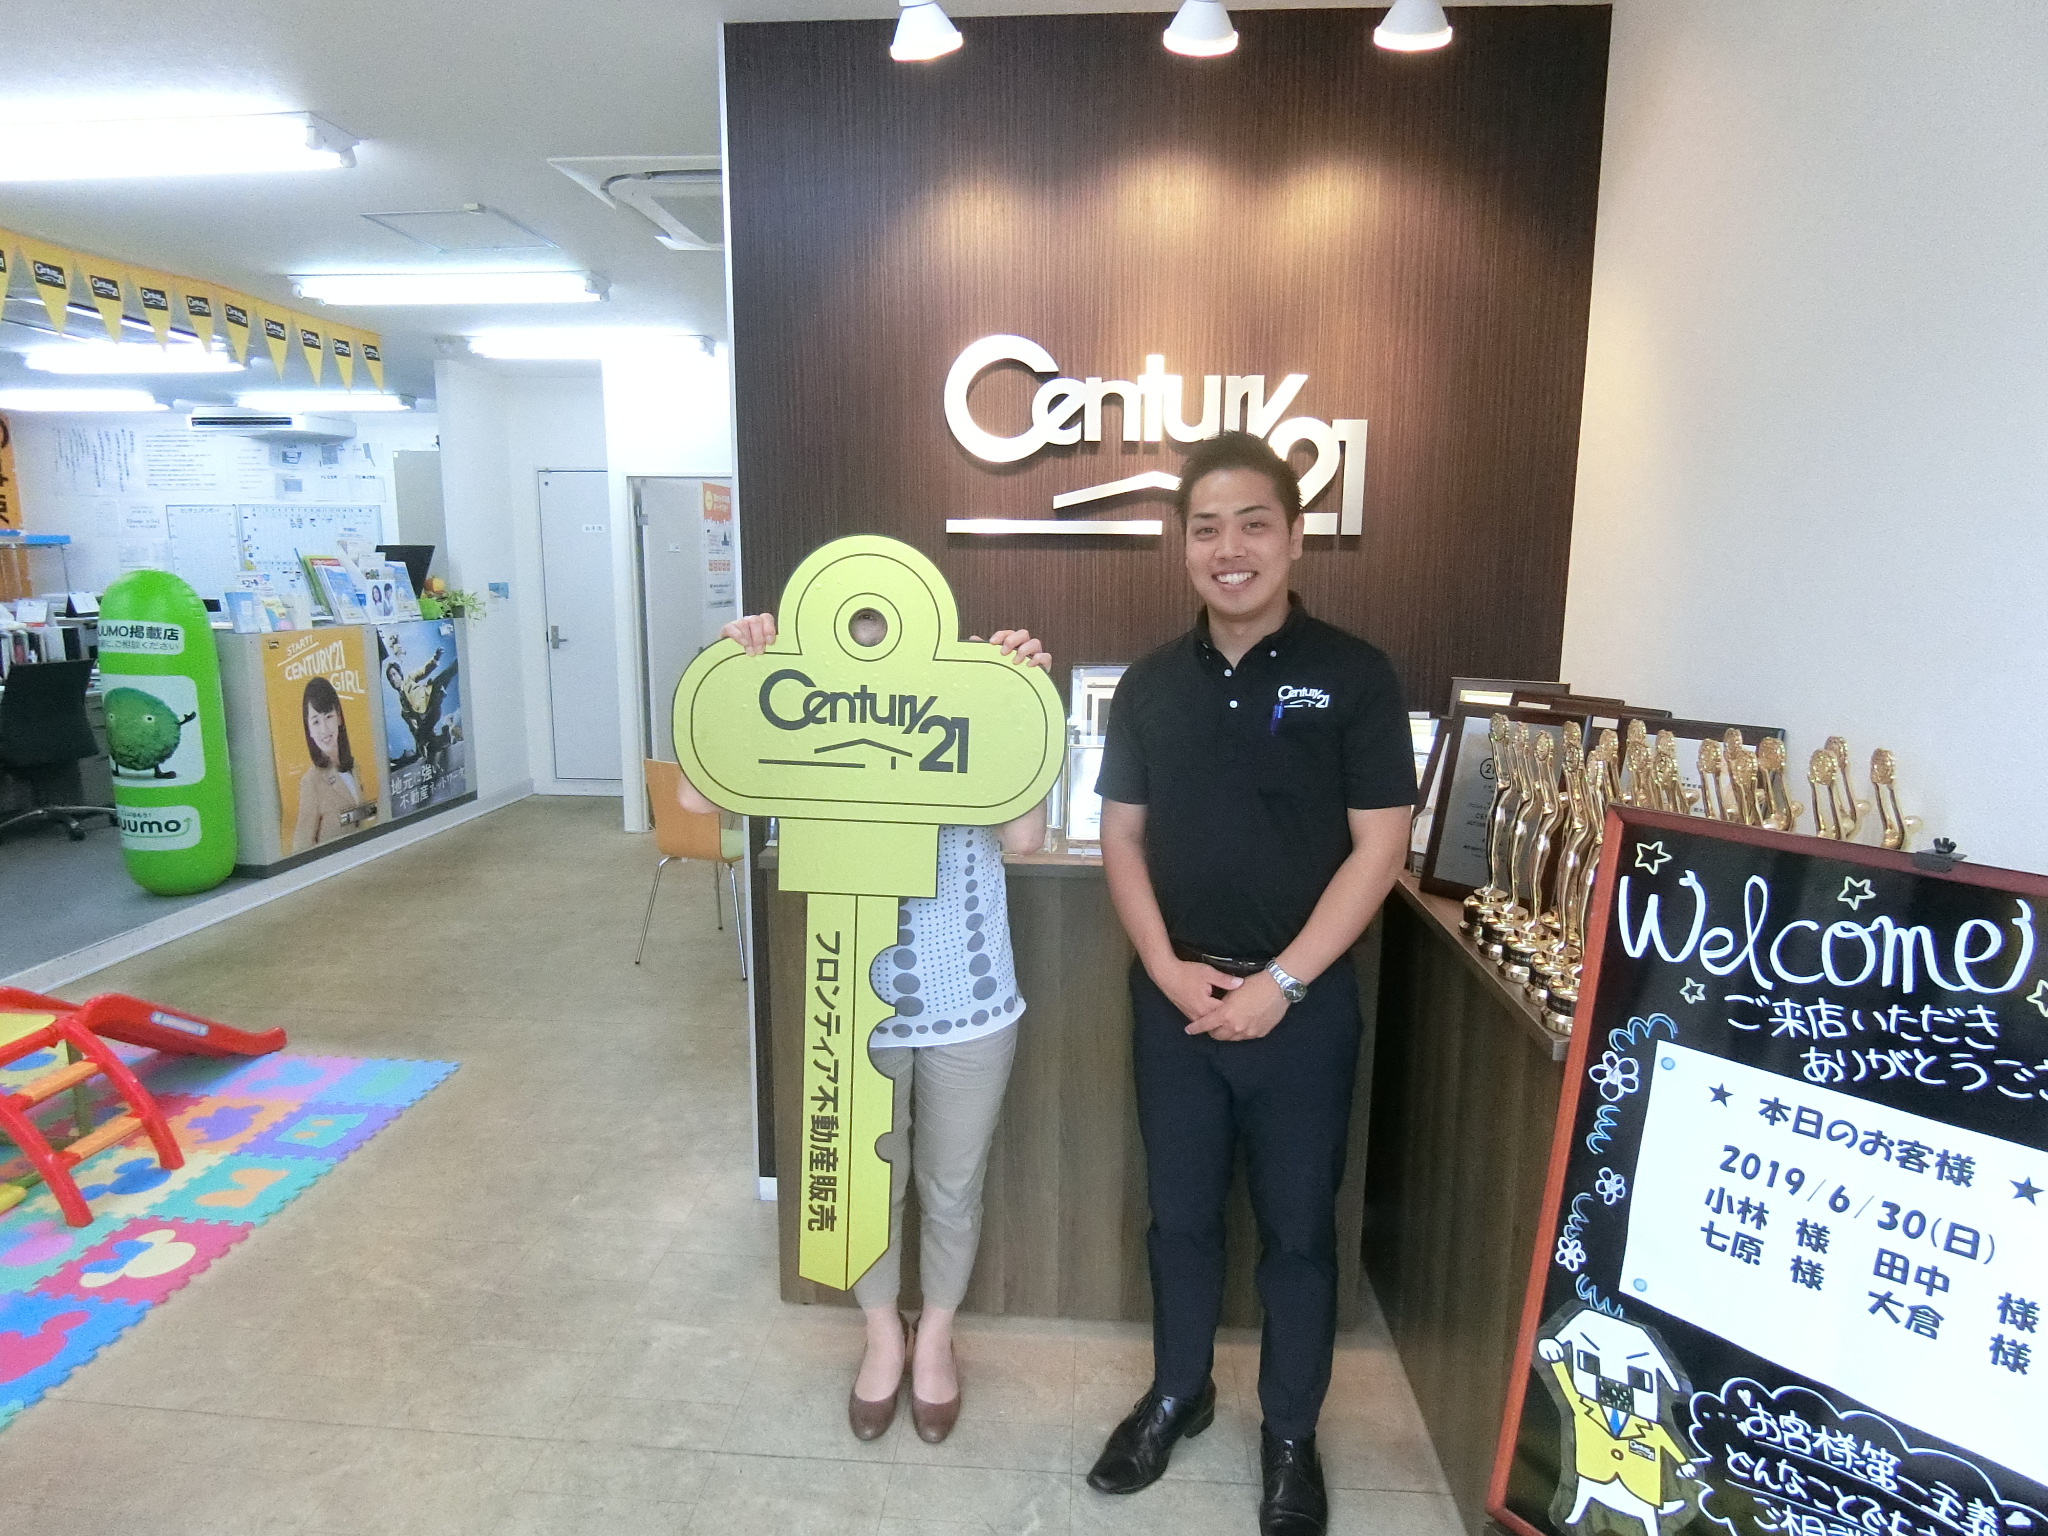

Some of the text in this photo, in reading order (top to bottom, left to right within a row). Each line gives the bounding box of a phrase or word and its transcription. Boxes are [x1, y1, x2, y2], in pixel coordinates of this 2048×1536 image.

[944, 334, 1368, 536] Century 21
[287, 634, 313, 656] START!
[330, 670, 365, 694] GIRL
[759, 668, 970, 774] Century 21
[1278, 685, 1331, 709] Century 21
[1724, 994, 2001, 1051] ご来店いただき
[805, 930, 842, 1233] フロンティア不動産販売
[1758, 1096, 1977, 1188] 本日のお客様
[1700, 1220, 2033, 1376] 七原 様 大倉 様
[1704, 1186, 2041, 1335] 小林 様 田中 様
